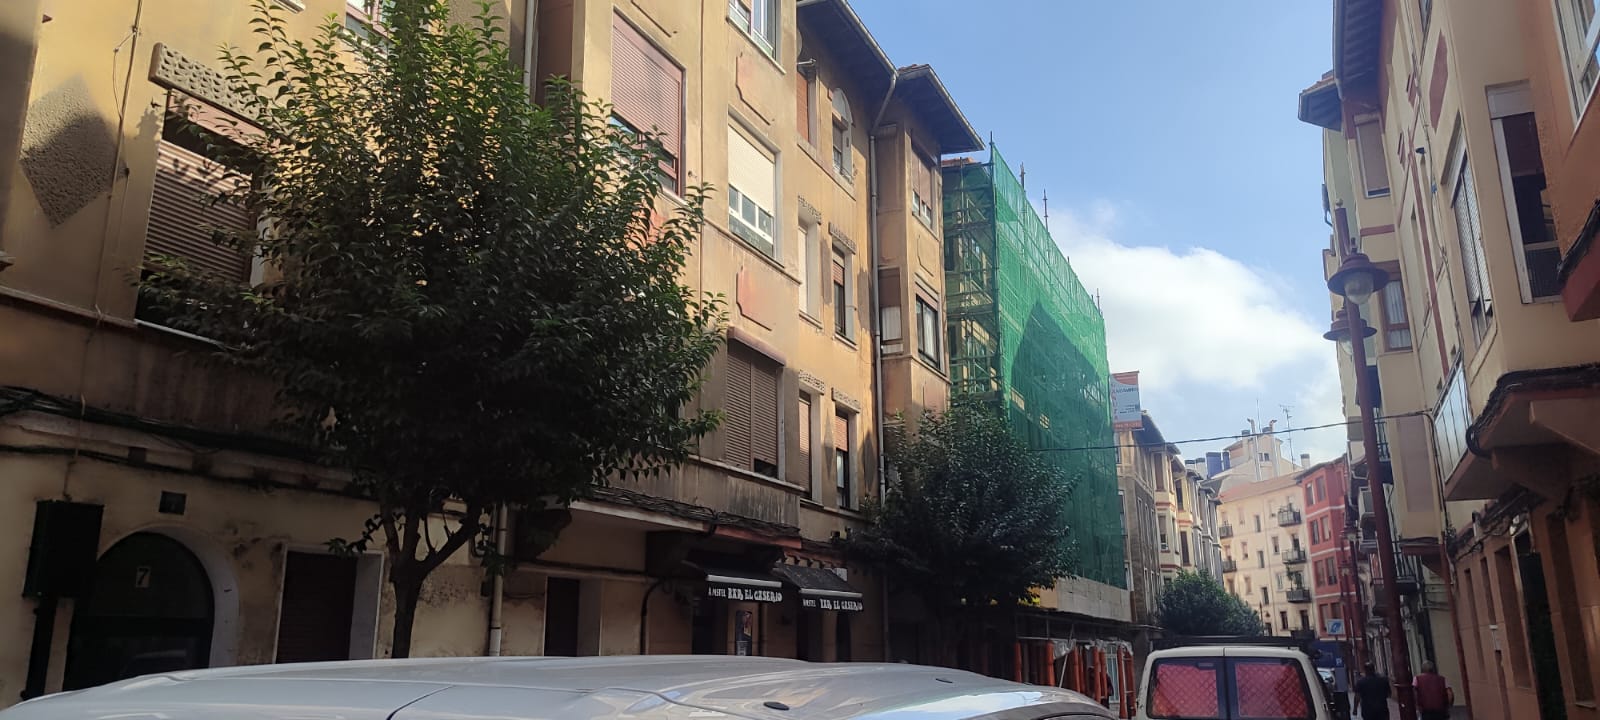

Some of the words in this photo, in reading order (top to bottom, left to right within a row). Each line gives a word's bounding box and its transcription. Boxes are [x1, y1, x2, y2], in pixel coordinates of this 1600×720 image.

[138, 568, 149, 585] 7
[728, 587, 744, 601] BAR
[744, 589, 753, 600] EL
[833, 600, 841, 610] EL
